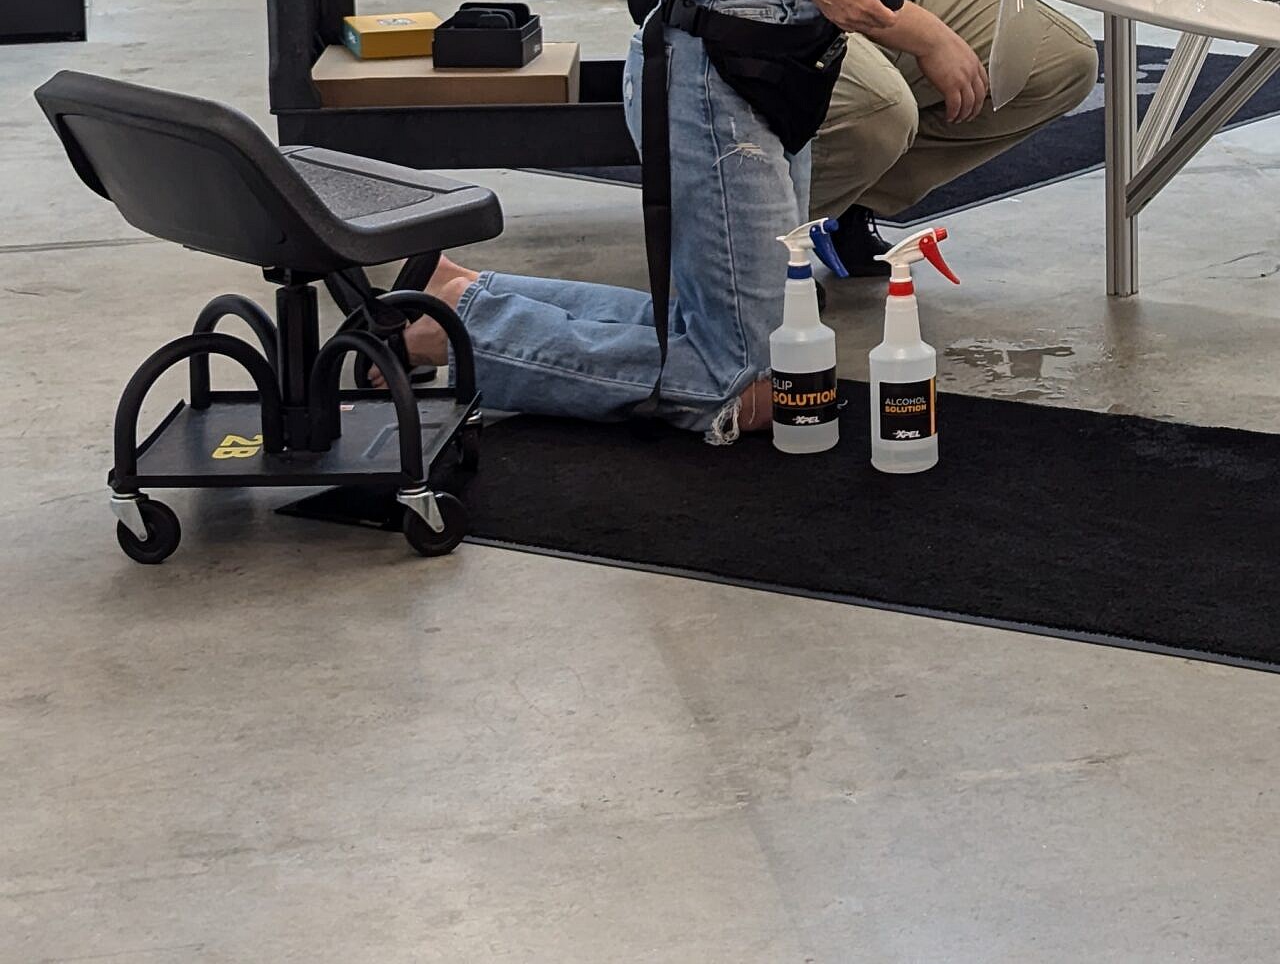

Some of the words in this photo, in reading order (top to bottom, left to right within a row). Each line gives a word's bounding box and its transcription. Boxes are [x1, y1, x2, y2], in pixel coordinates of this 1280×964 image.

[772, 388, 837, 406] SOLUTION
[885, 397, 926, 406] ALCOHOL
[885, 404, 927, 413] SOLUTION
[792, 415, 820, 424] XPEL
[892, 430, 921, 439] XPEL
